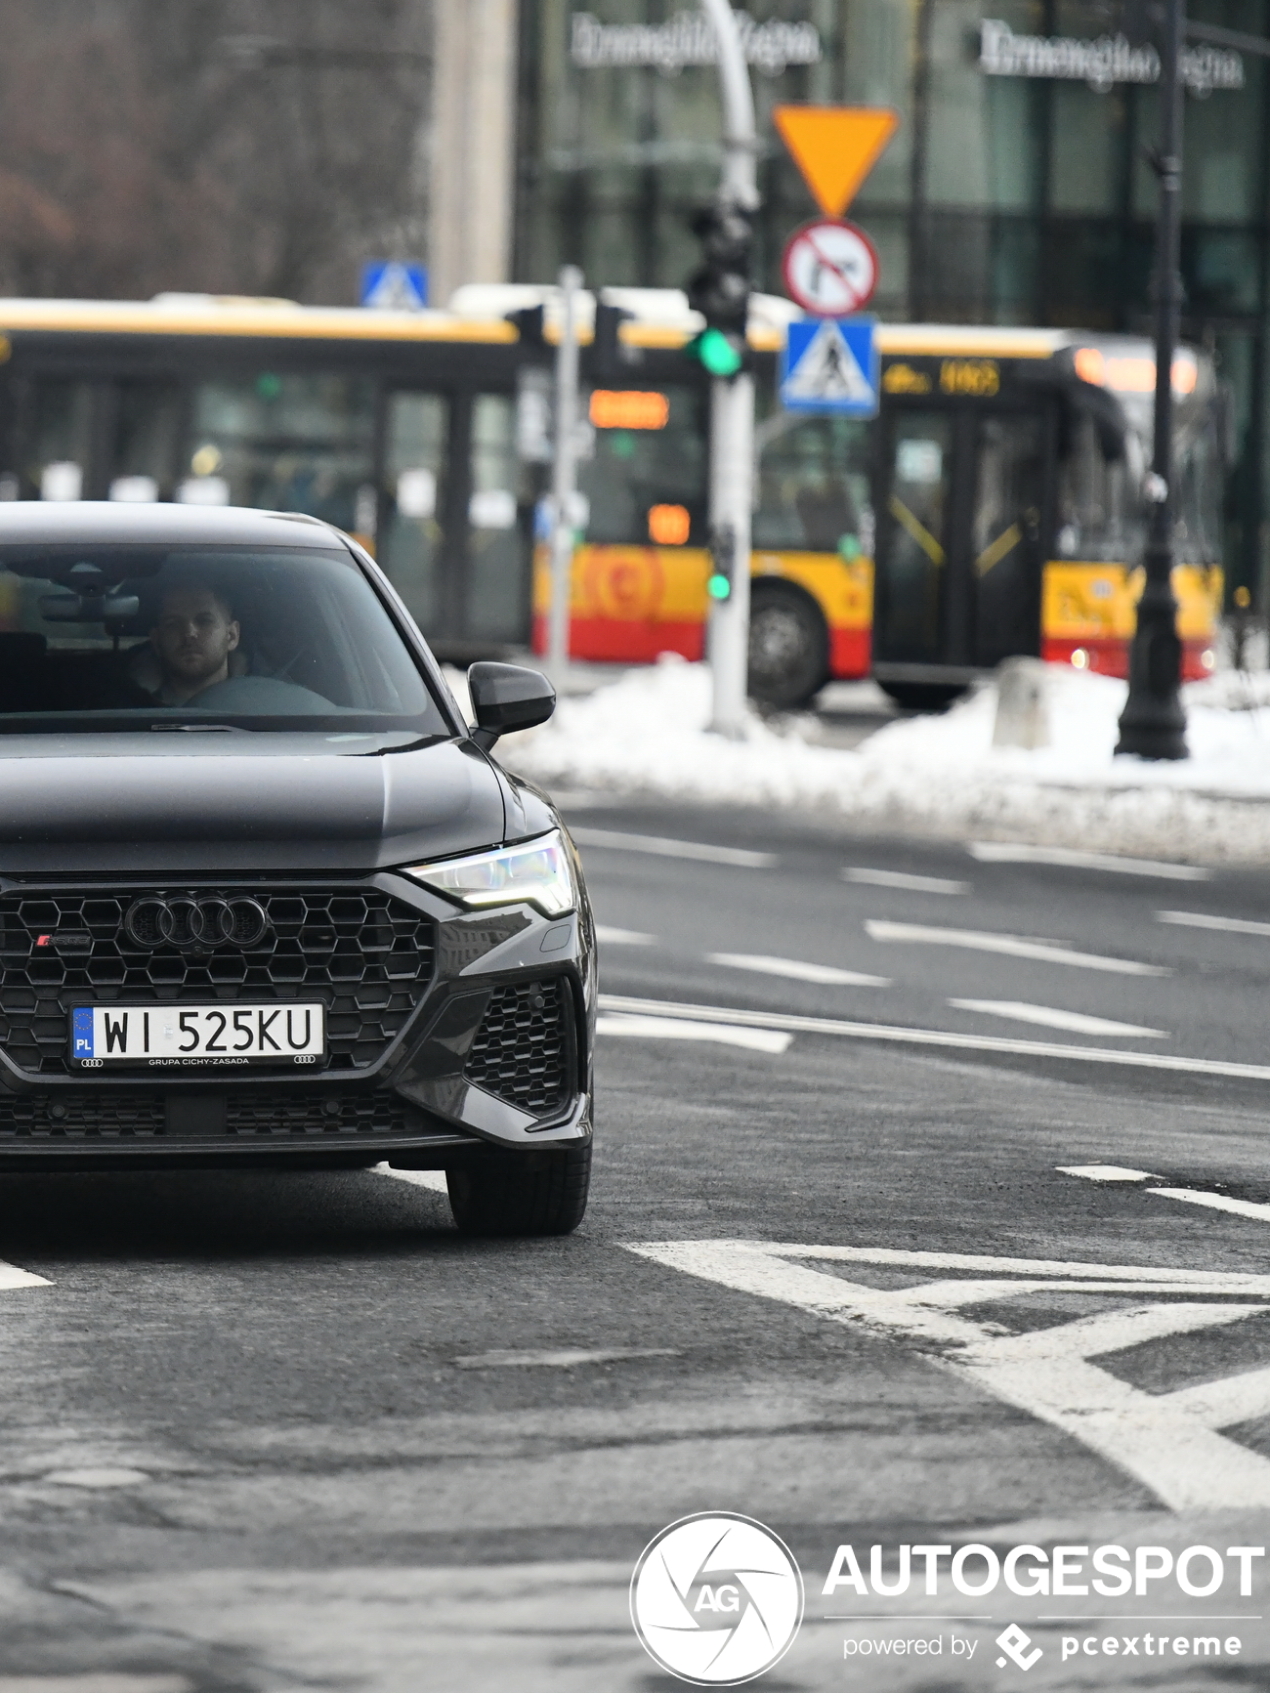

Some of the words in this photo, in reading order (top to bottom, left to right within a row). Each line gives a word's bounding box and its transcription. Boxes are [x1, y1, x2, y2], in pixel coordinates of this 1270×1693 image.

[572, 11, 720, 77] Ermenegild
[1175, 45, 1245, 99] egna
[76, 1039, 91, 1051] PL
[103, 1011, 150, 1053] WI
[178, 1009, 311, 1052] 525KU
[148, 1058, 180, 1066] GRUPA
[181, 1057, 249, 1066] CICHY-ZASADA
